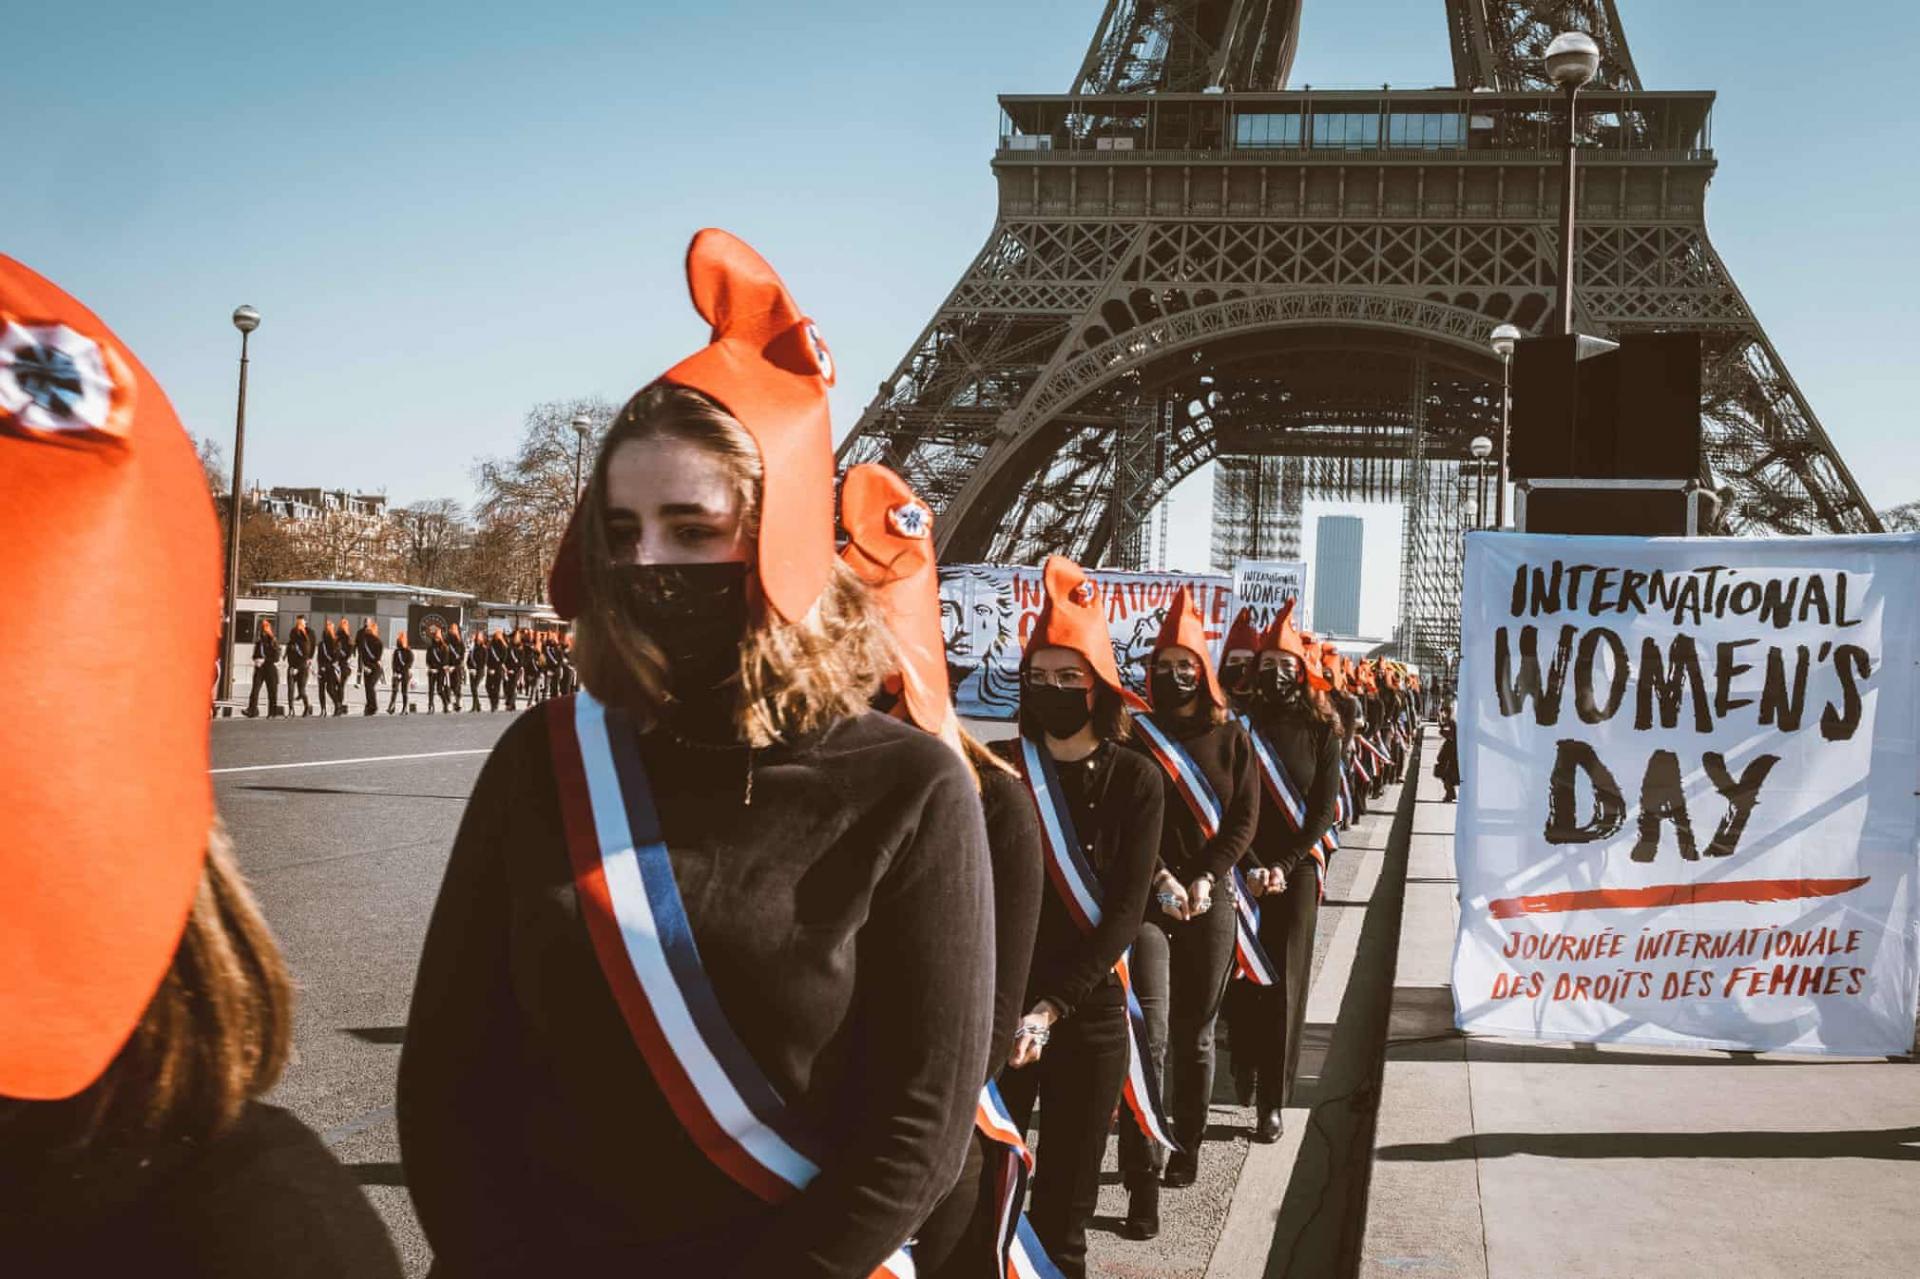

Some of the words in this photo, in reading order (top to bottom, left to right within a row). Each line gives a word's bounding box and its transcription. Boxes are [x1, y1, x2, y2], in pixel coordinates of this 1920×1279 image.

[1495, 624, 1871, 741] WOMEN'S
[1544, 739, 1781, 863] DAY
[1491, 971, 1545, 1000] DES
[1661, 970, 1714, 1001] DES
[1723, 964, 1866, 998] FEMMES
[1503, 927, 1627, 961] JOURNÉE
